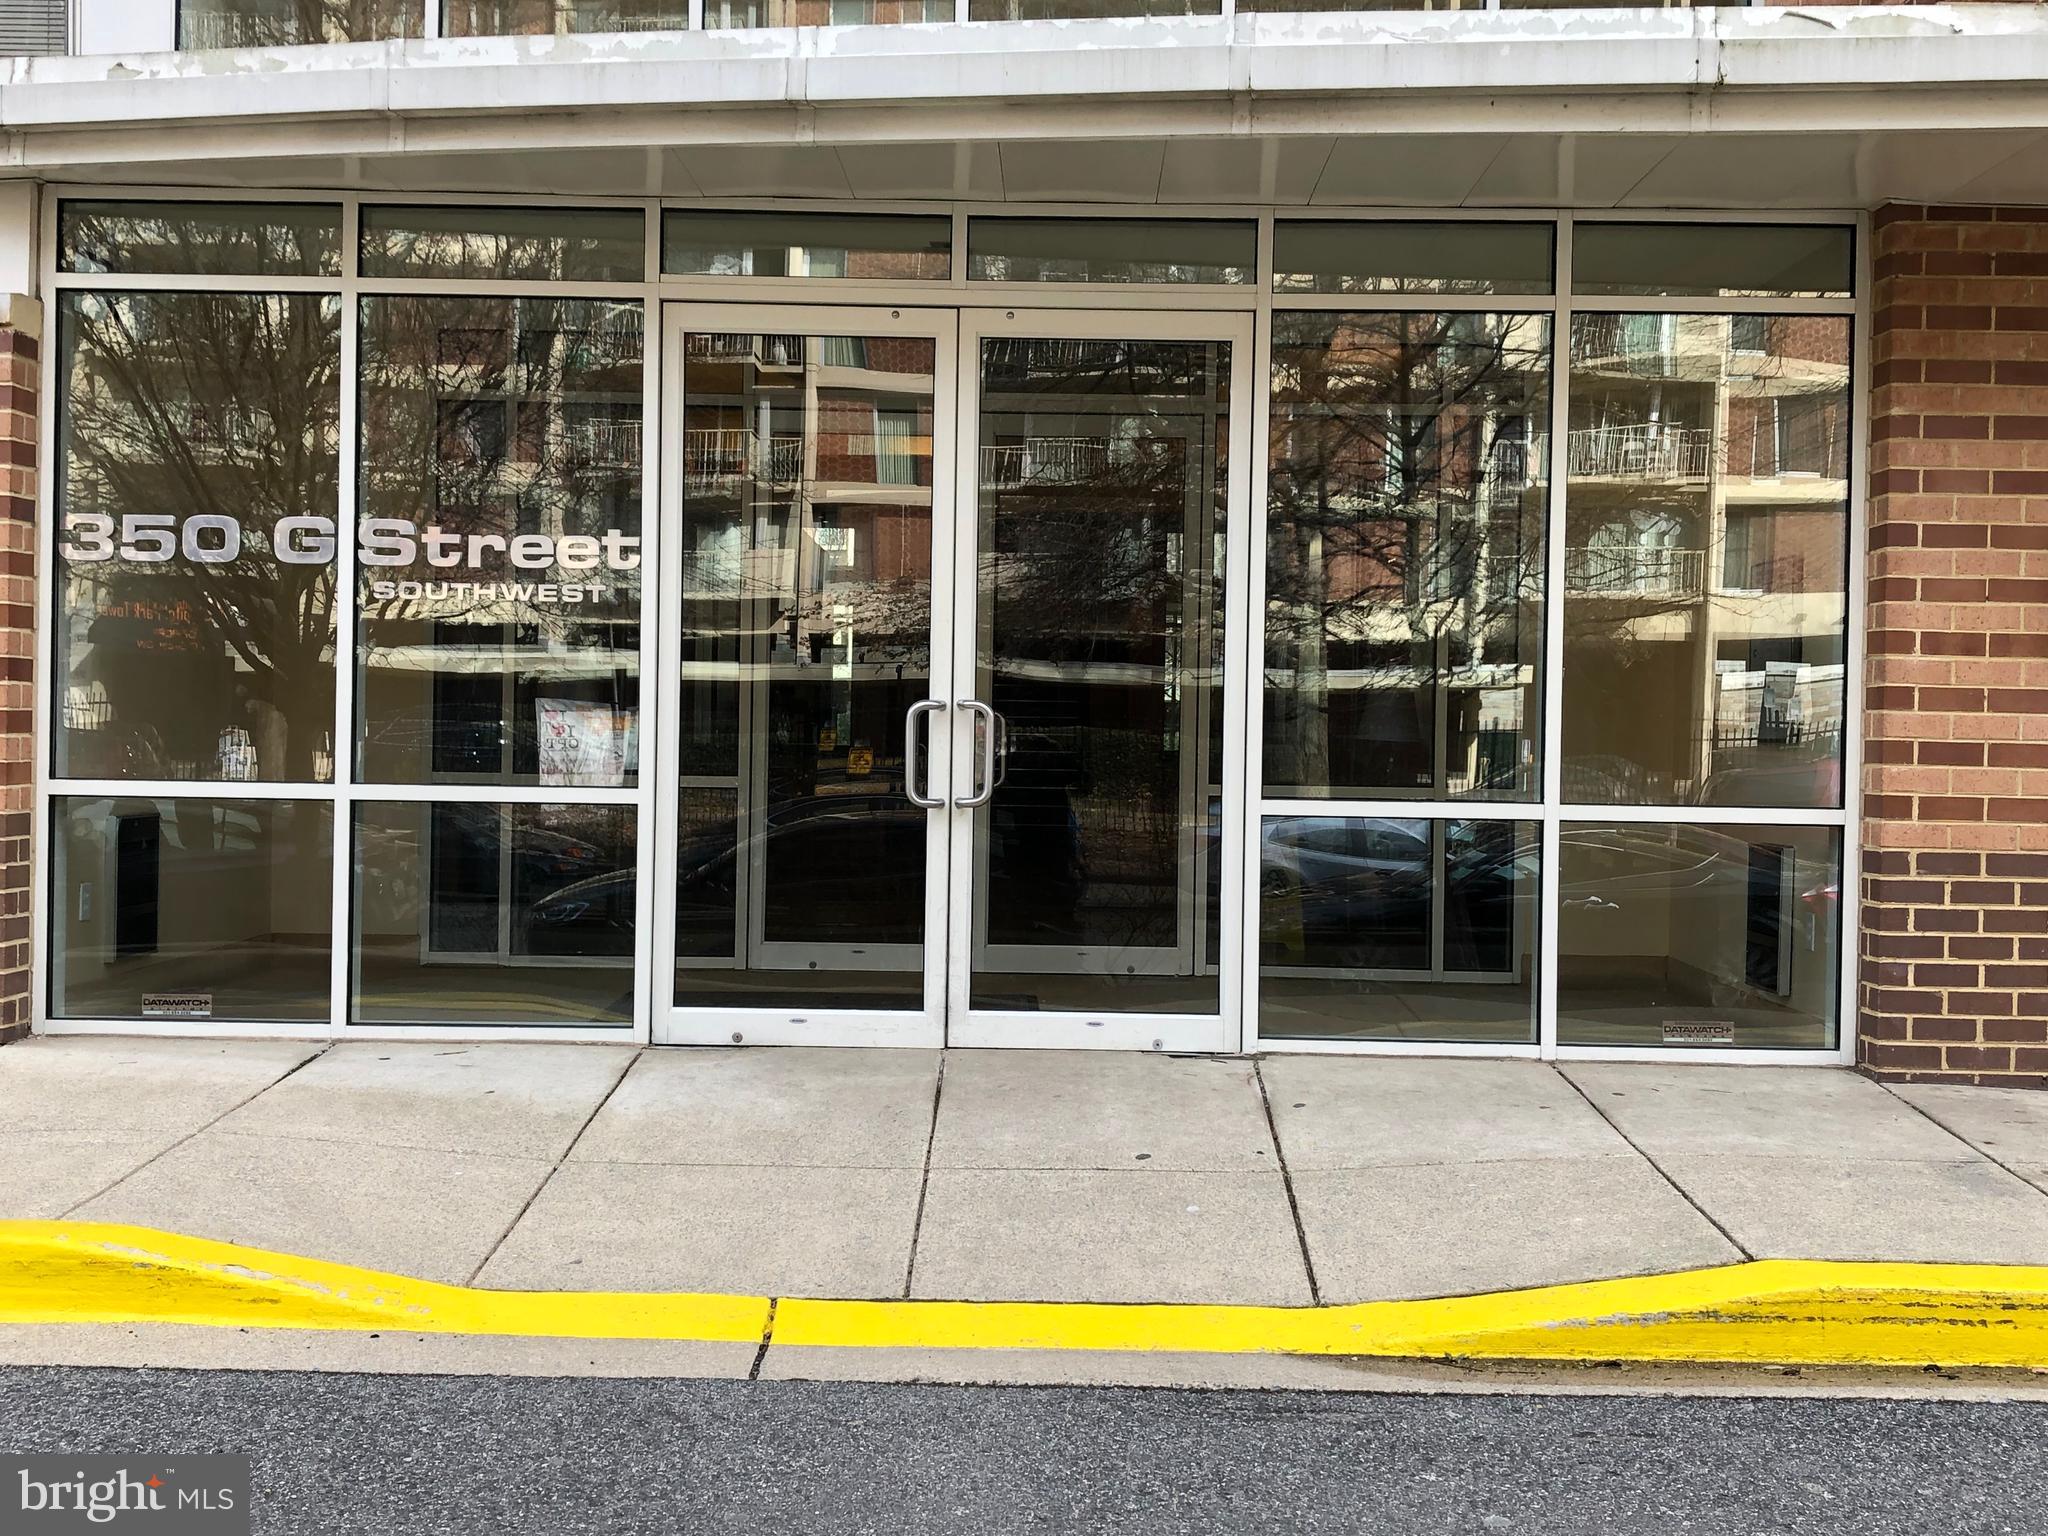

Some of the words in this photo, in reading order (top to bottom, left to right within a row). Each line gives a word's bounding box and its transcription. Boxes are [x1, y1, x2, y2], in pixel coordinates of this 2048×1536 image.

[59, 514, 240, 564] 350
[274, 515, 335, 564] G
[356, 518, 640, 570] Street
[372, 581, 606, 604] SOUTHWEST
